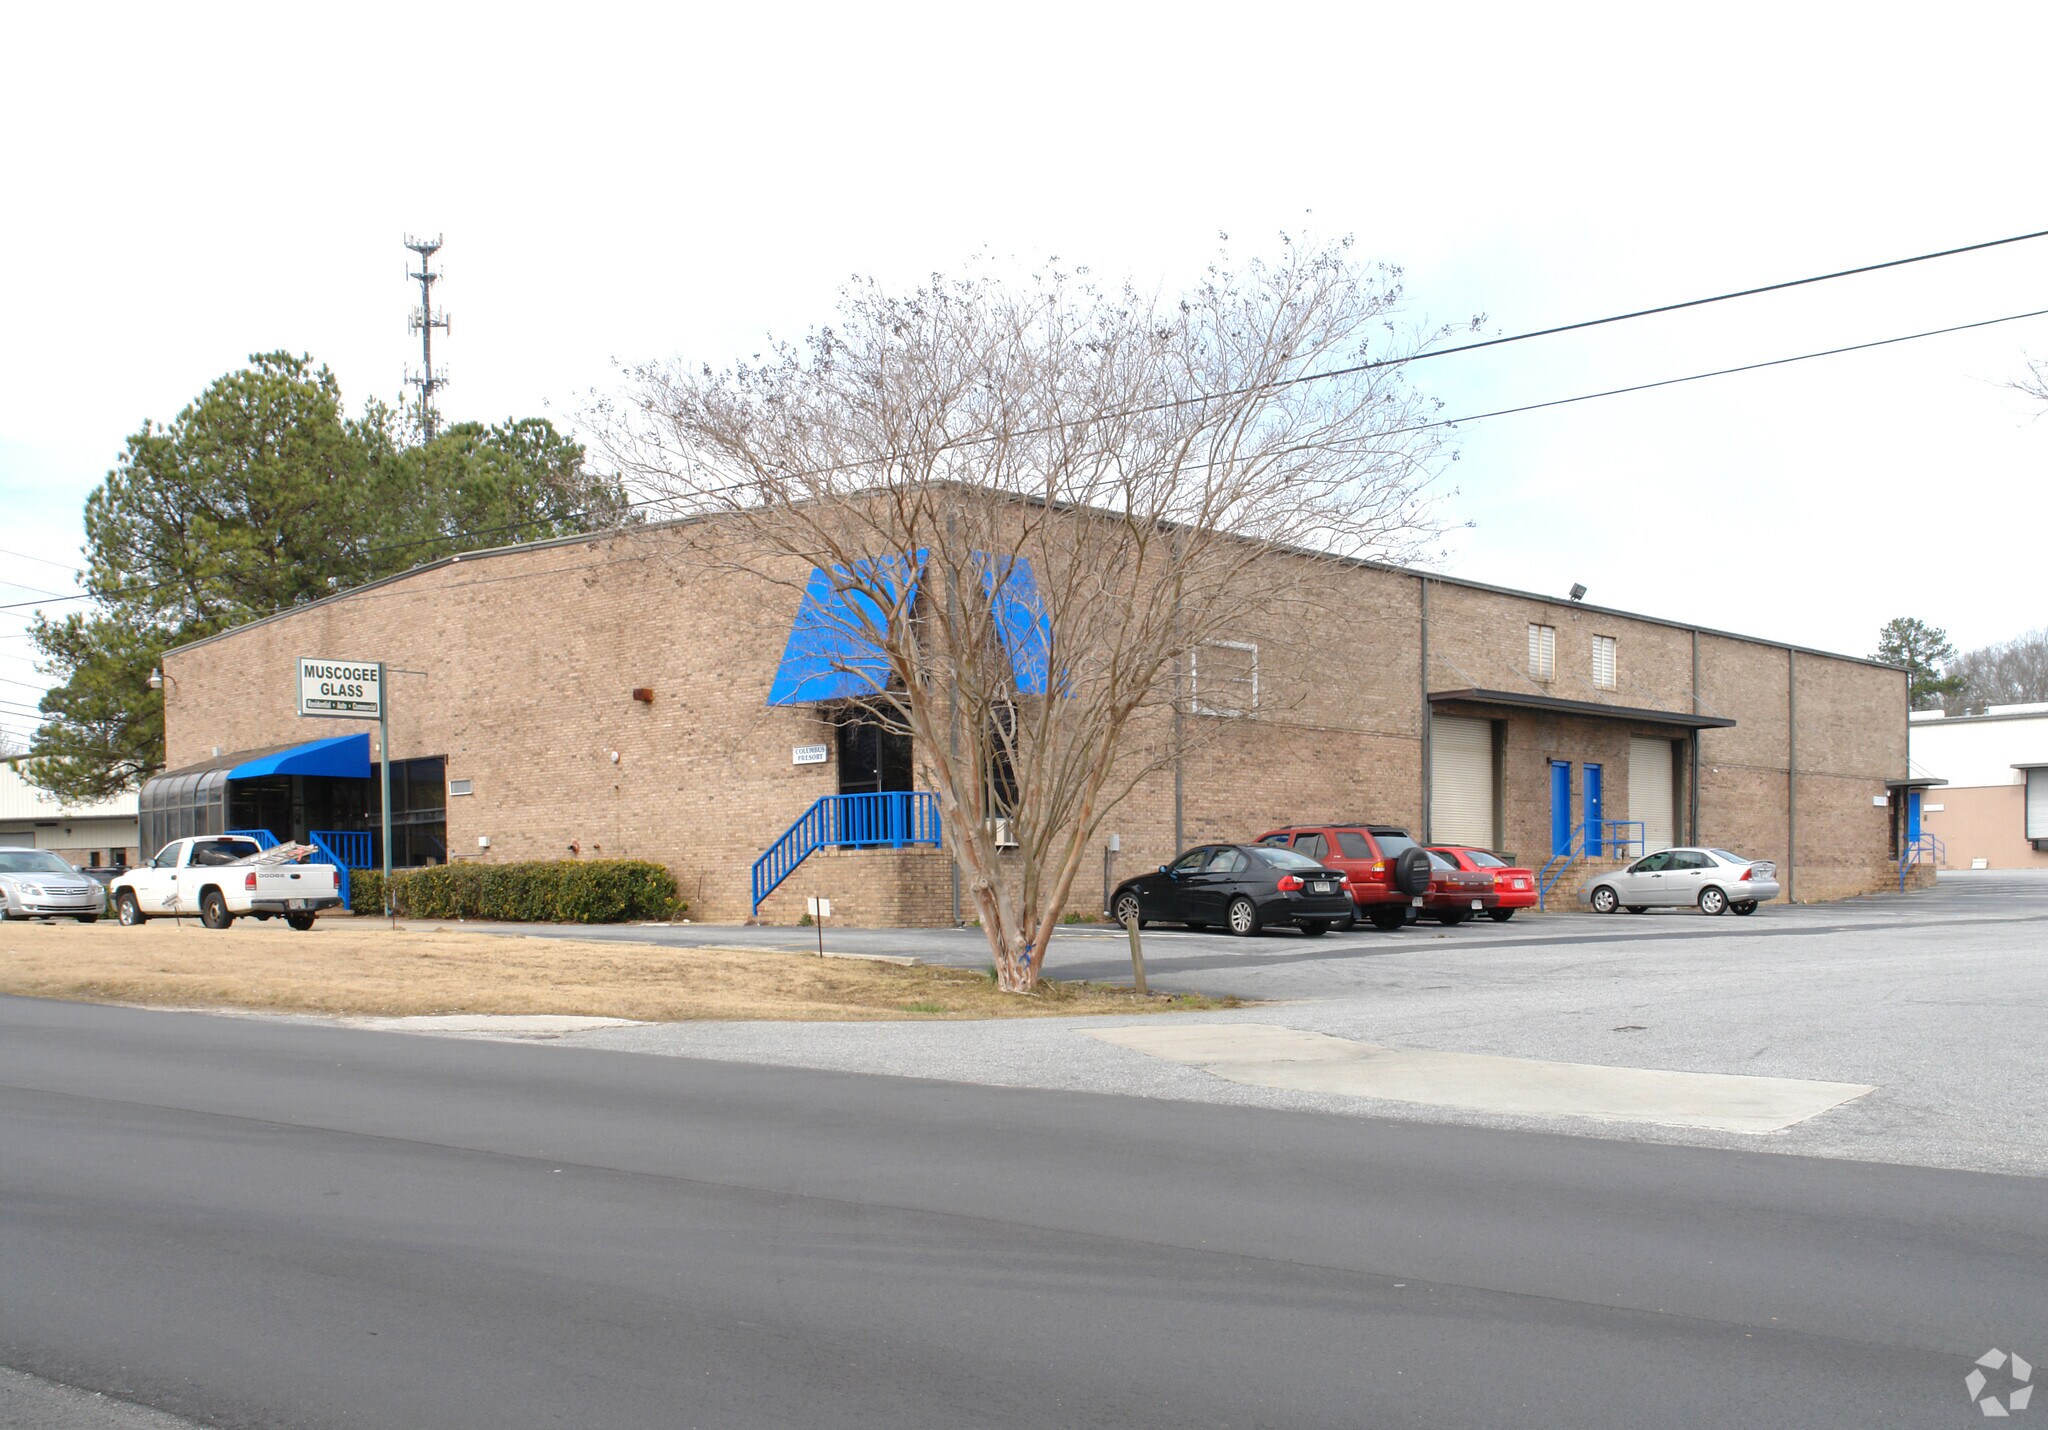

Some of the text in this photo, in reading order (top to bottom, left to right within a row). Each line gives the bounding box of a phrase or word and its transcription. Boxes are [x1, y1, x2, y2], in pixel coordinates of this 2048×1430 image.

[304, 665, 378, 681] MUSCOGEE
[321, 683, 363, 697] GLASS
[795, 747, 825, 755] COLUMBUS
